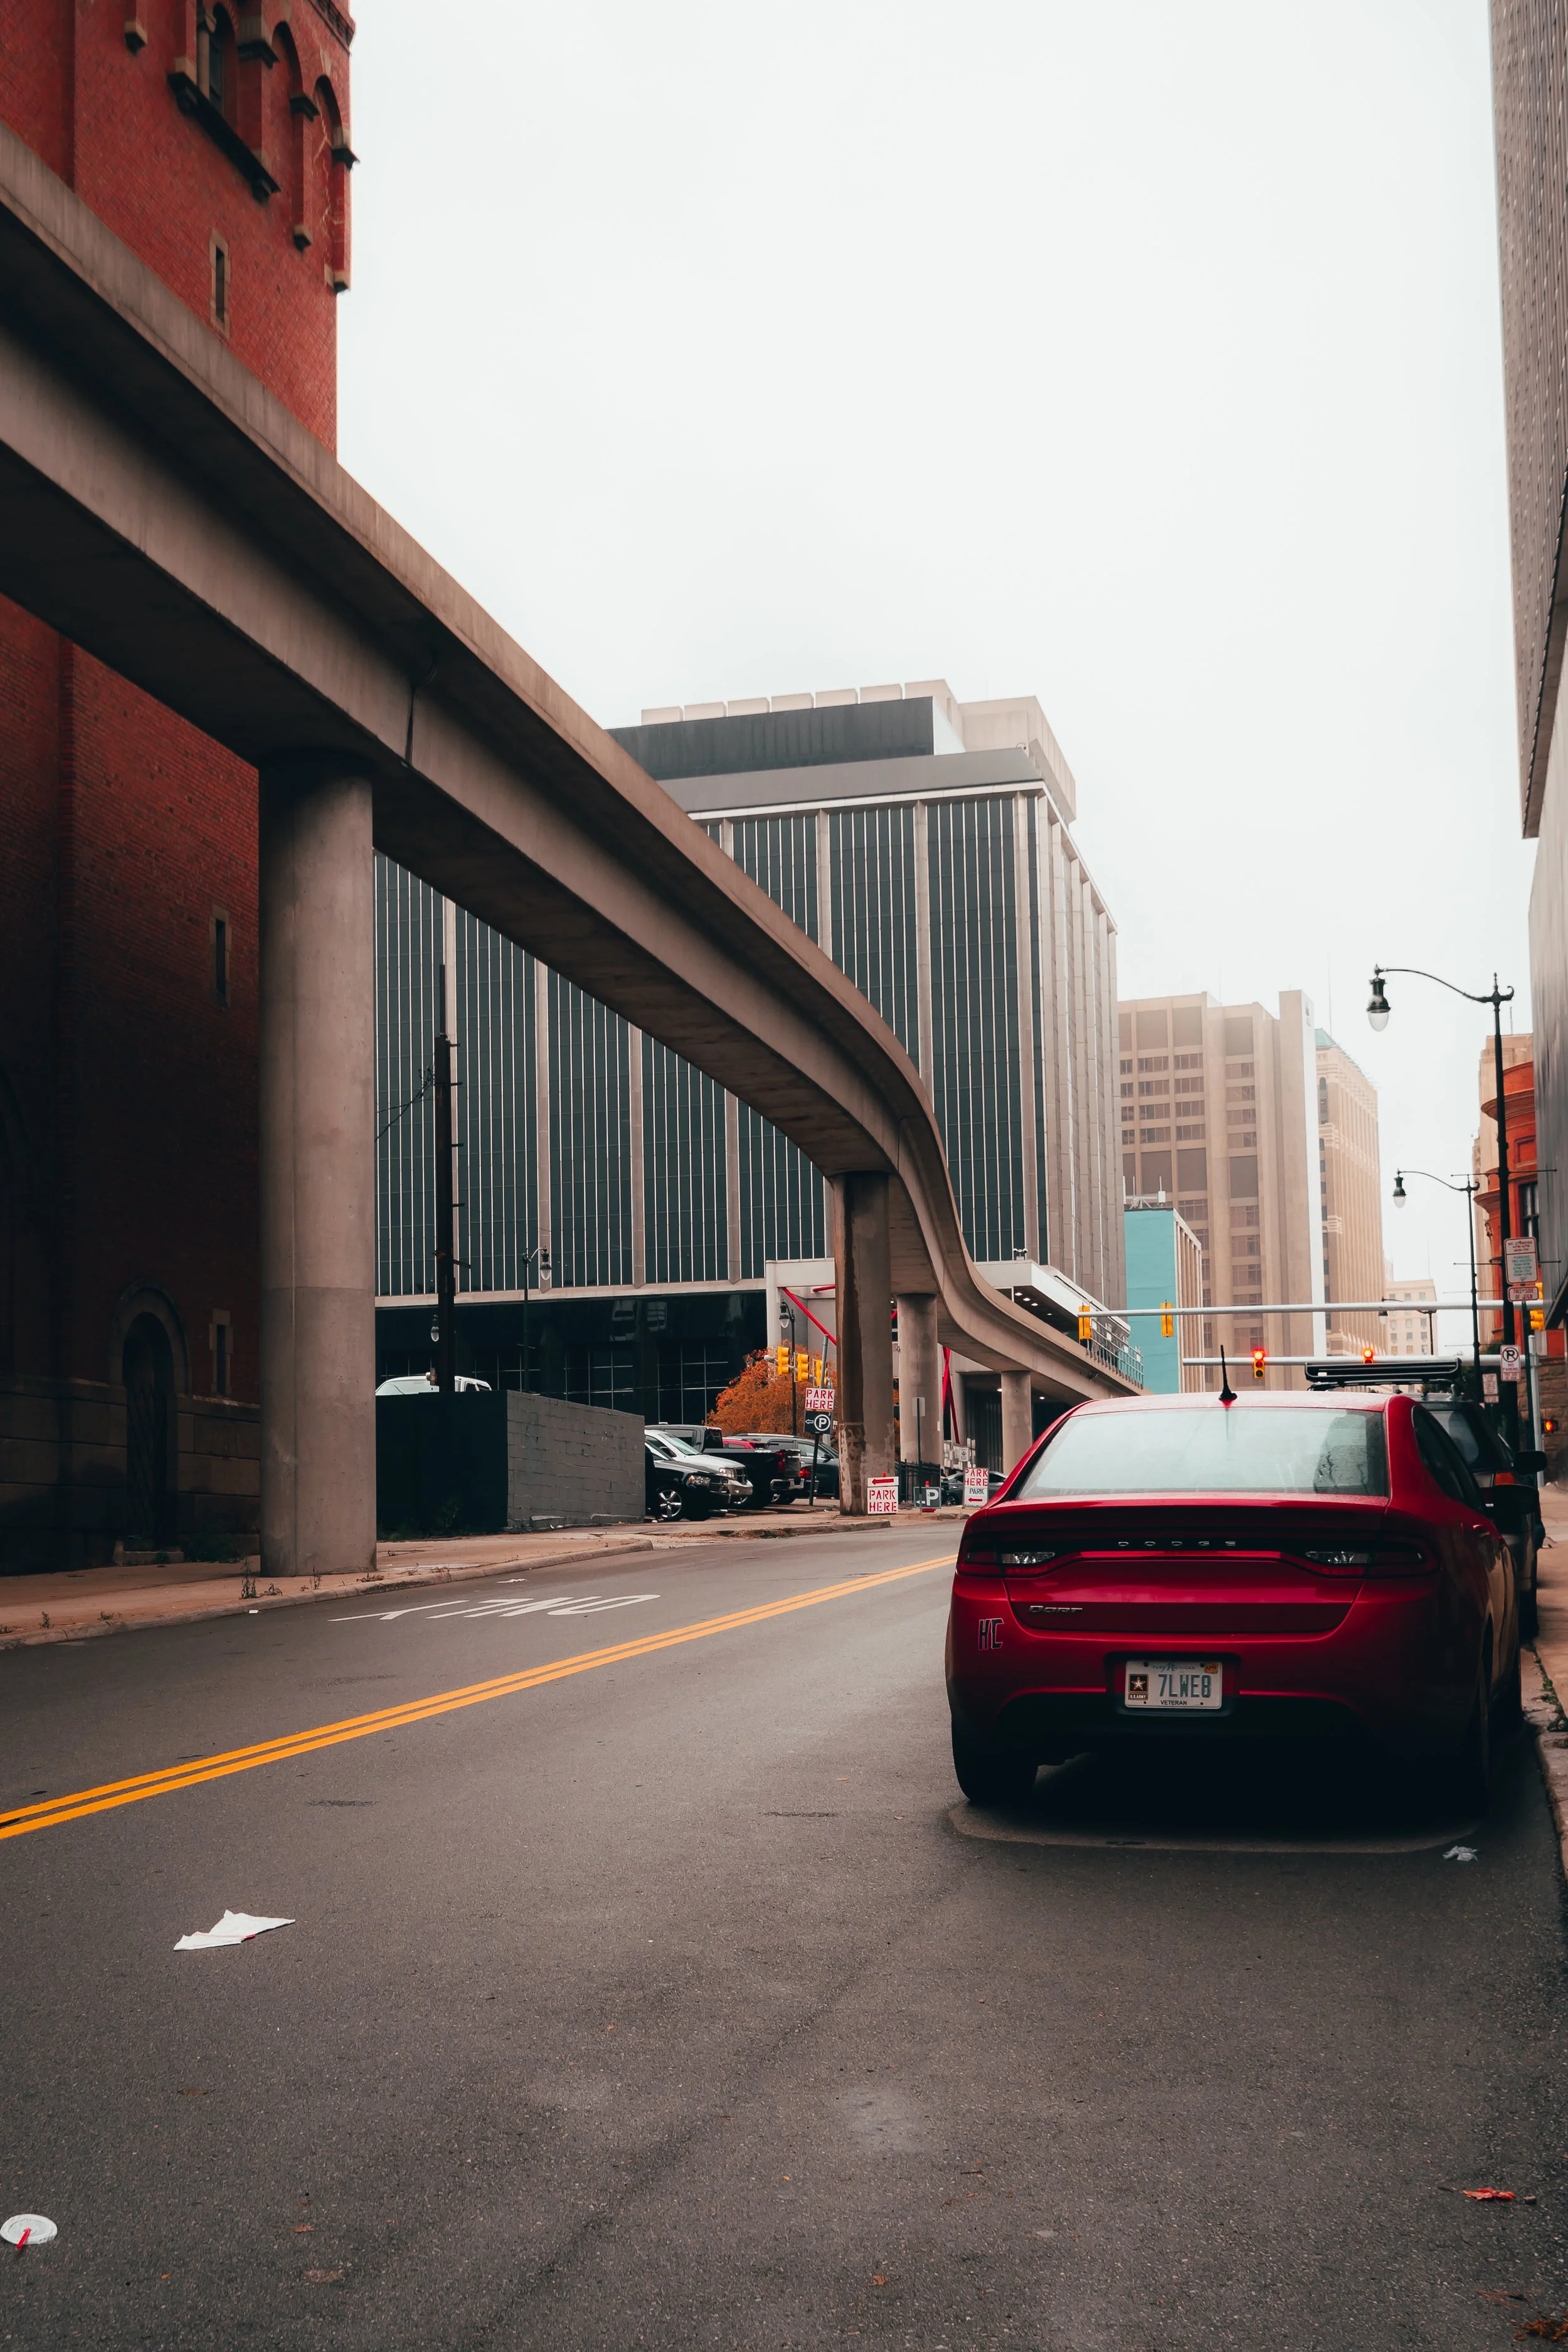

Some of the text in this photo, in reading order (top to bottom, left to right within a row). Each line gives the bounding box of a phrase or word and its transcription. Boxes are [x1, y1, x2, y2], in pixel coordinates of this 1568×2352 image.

[807, 1389, 833, 1399] PARK
[806, 1399, 833, 1409] HERE
[965, 1468, 988, 1477] PARK
[964, 1478, 988, 1486] HERE
[869, 1490, 896, 1500] PARK
[869, 1502, 897, 1512] HERE
[1158, 1674, 1211, 1698] 7LWE8
